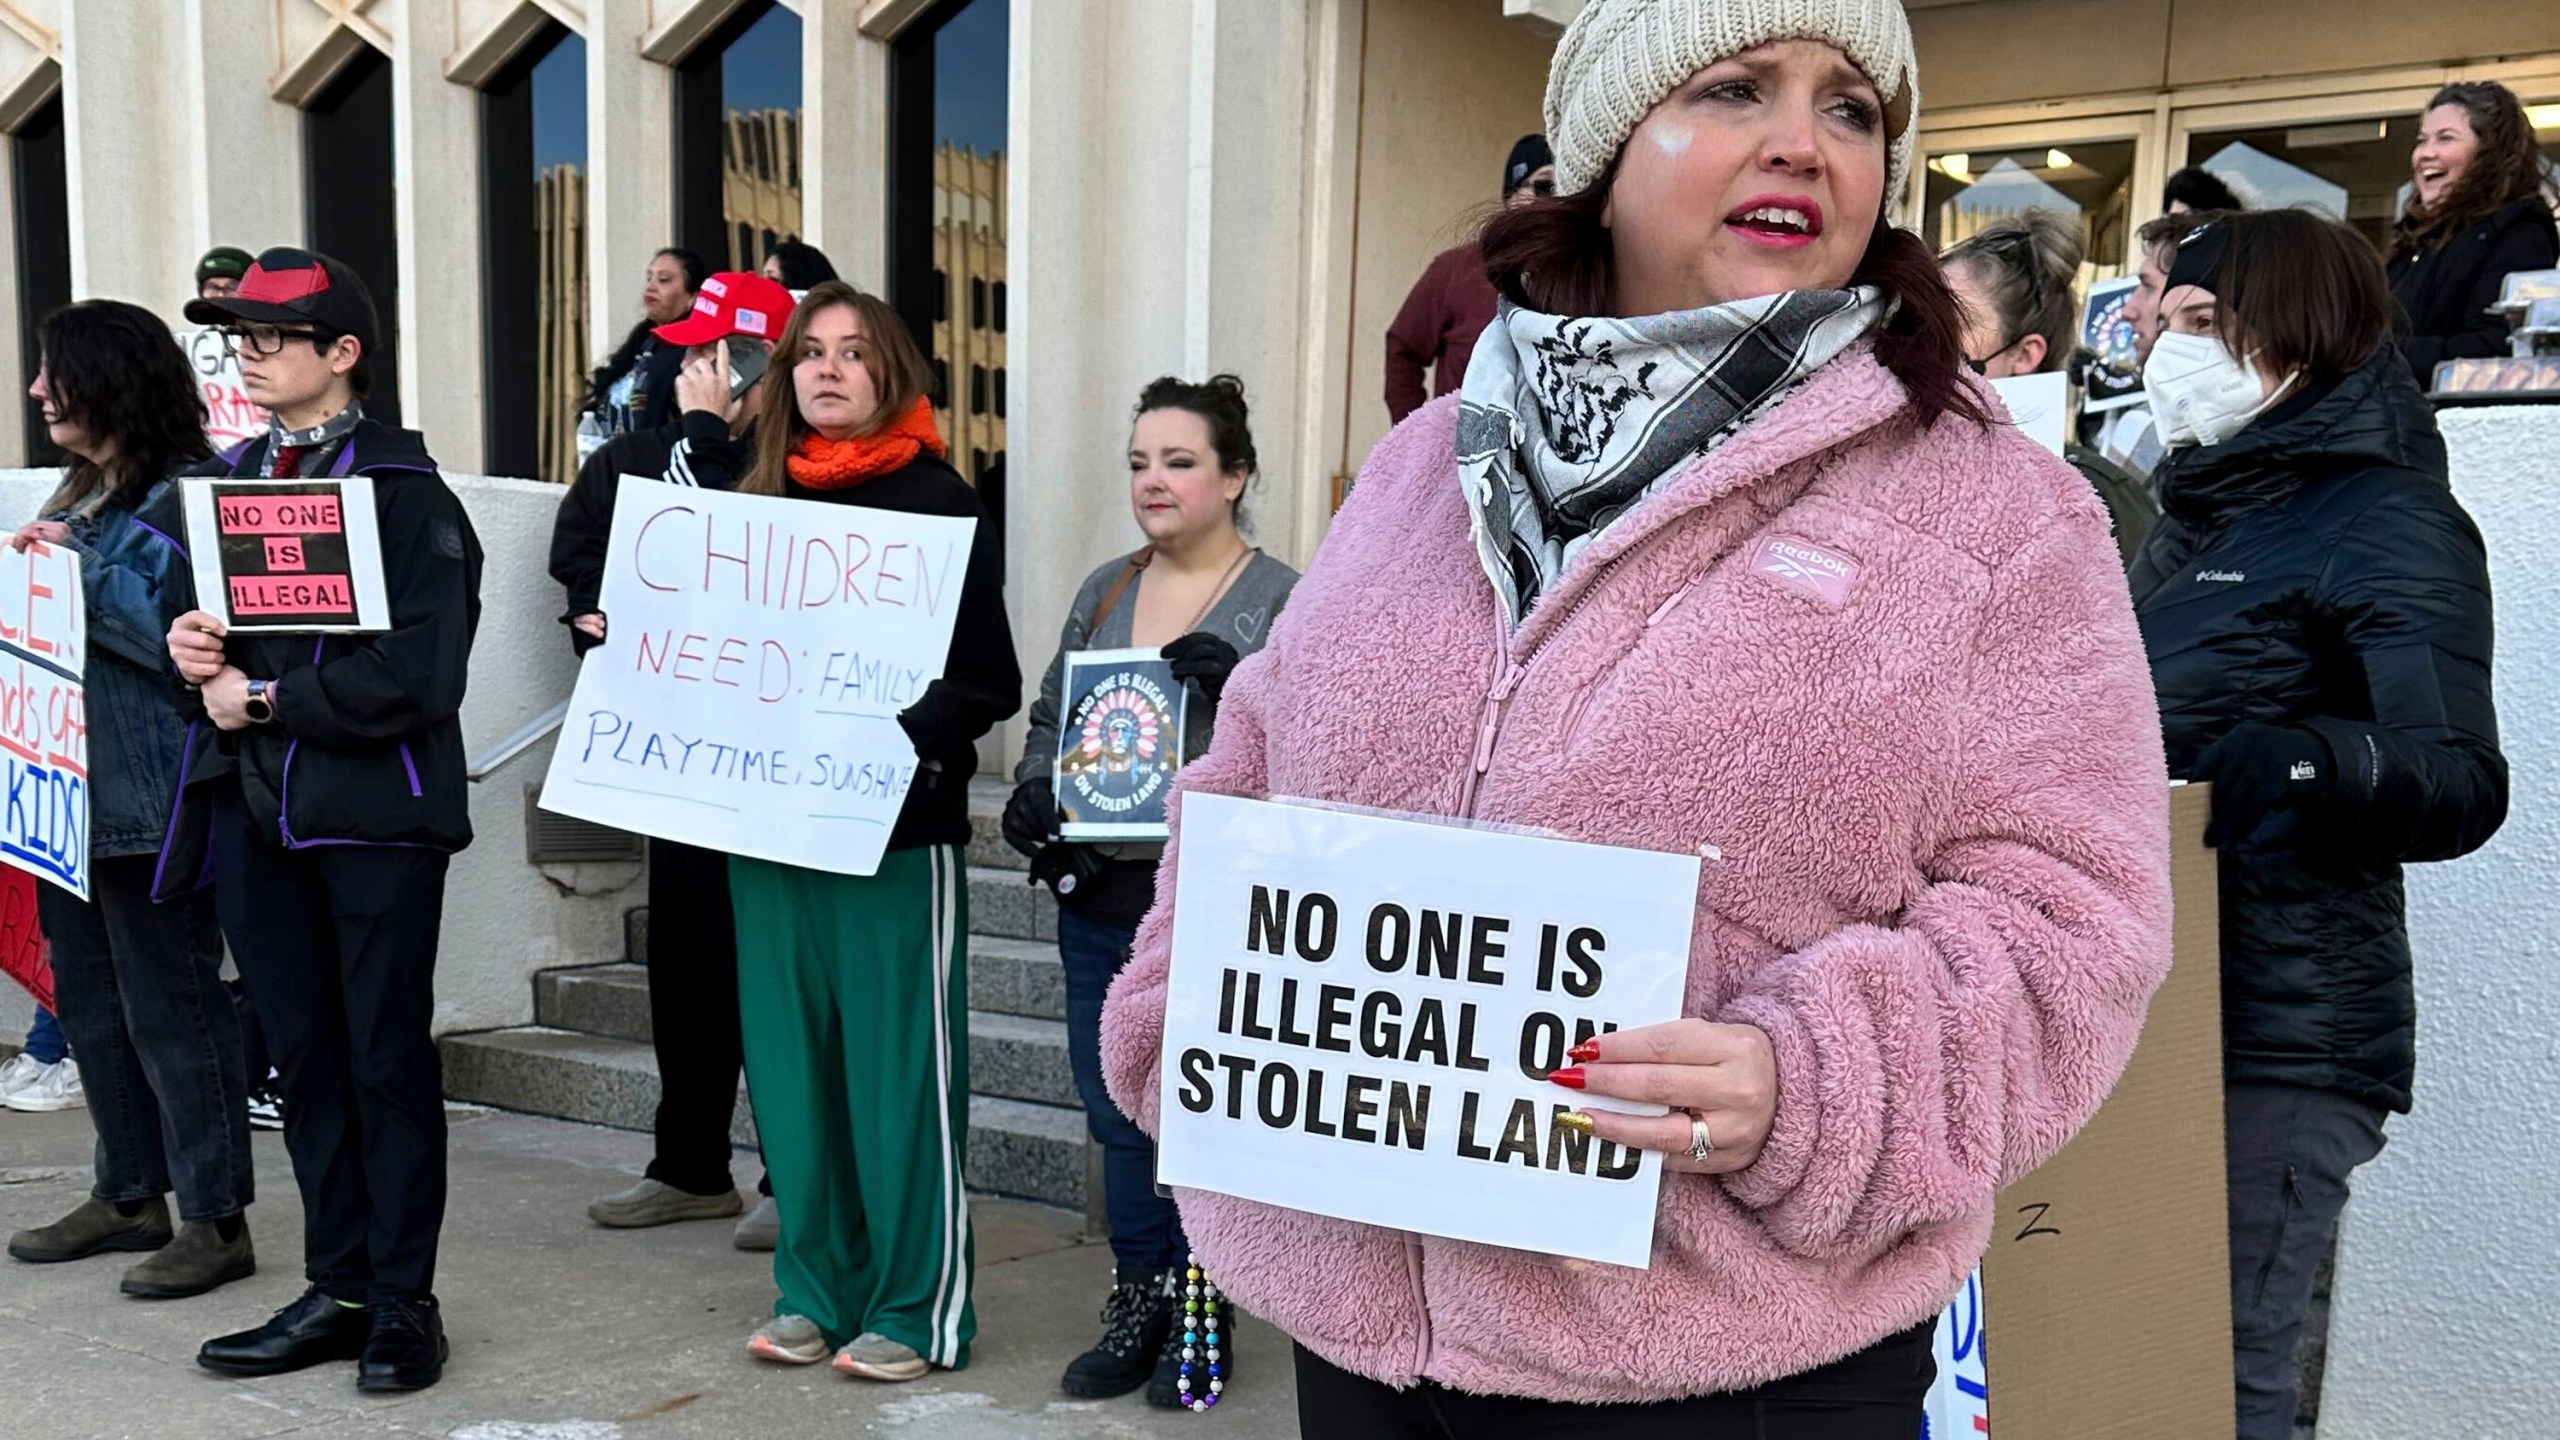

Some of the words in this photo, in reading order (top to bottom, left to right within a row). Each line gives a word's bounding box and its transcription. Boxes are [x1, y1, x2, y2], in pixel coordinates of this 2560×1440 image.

[222, 505, 262, 527] NO
[277, 504, 338, 526] ONE
[268, 545, 300, 564] IS
[1768, 541, 1849, 577] Reebok
[232, 585, 348, 608] ILLEGAL
[819, 652, 924, 705] FAMILY
[1077, 695, 1095, 717] NO
[1093, 674, 1117, 698] ONE
[1118, 672, 1131, 687] IS
[1131, 673, 1169, 713] ILLEGAL
[1074, 774, 1092, 797] ON
[1089, 790, 1132, 812] STOLEN
[1132, 773, 1162, 805] LAND
[7, 758, 87, 895] KIDS!
[1246, 884, 1338, 963] NO
[1365, 902, 1510, 985] ONE
[1535, 924, 1606, 998] IS
[1217, 968, 1490, 1072] ILLEGAL
[1178, 1047, 1432, 1151] STOLEN
